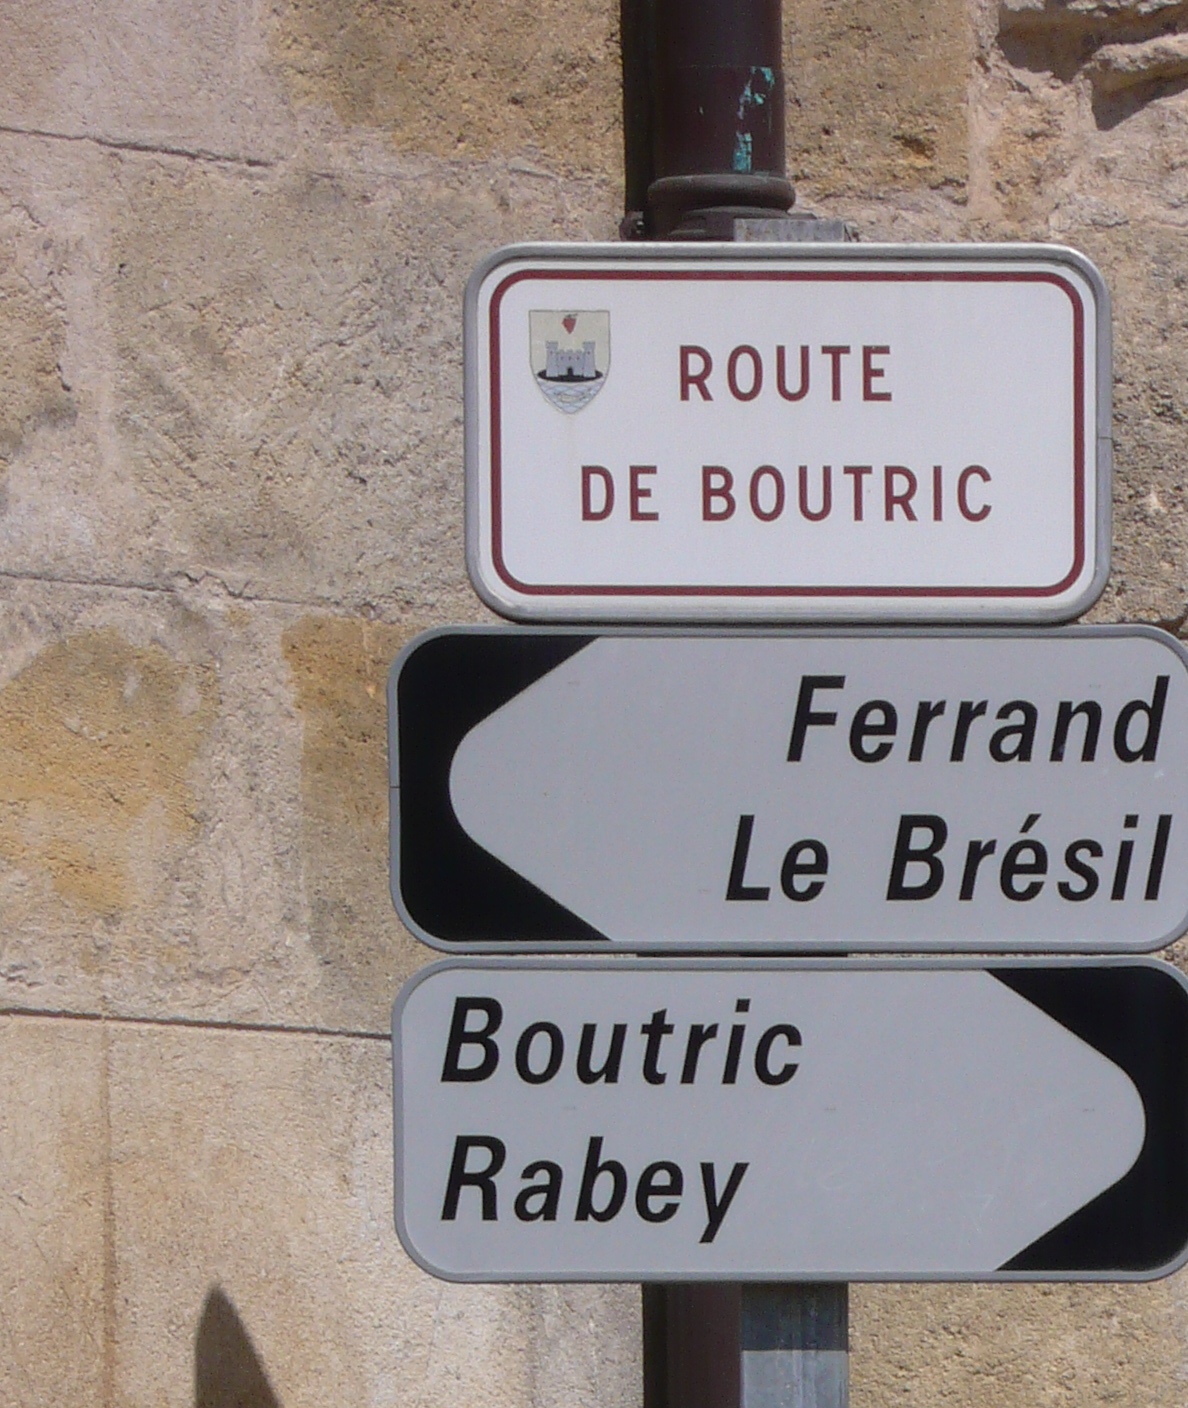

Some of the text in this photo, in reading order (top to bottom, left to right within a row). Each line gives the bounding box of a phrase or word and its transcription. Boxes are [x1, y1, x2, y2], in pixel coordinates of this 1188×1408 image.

[678, 344, 893, 403] ROUTE
[580, 464, 993, 523] DE BOUTRIC
[786, 674, 1170, 764] Ferrand
[725, 812, 1174, 903] Le Brésil
[439, 996, 803, 1087] Boutric
[439, 1134, 750, 1245] Rabey
